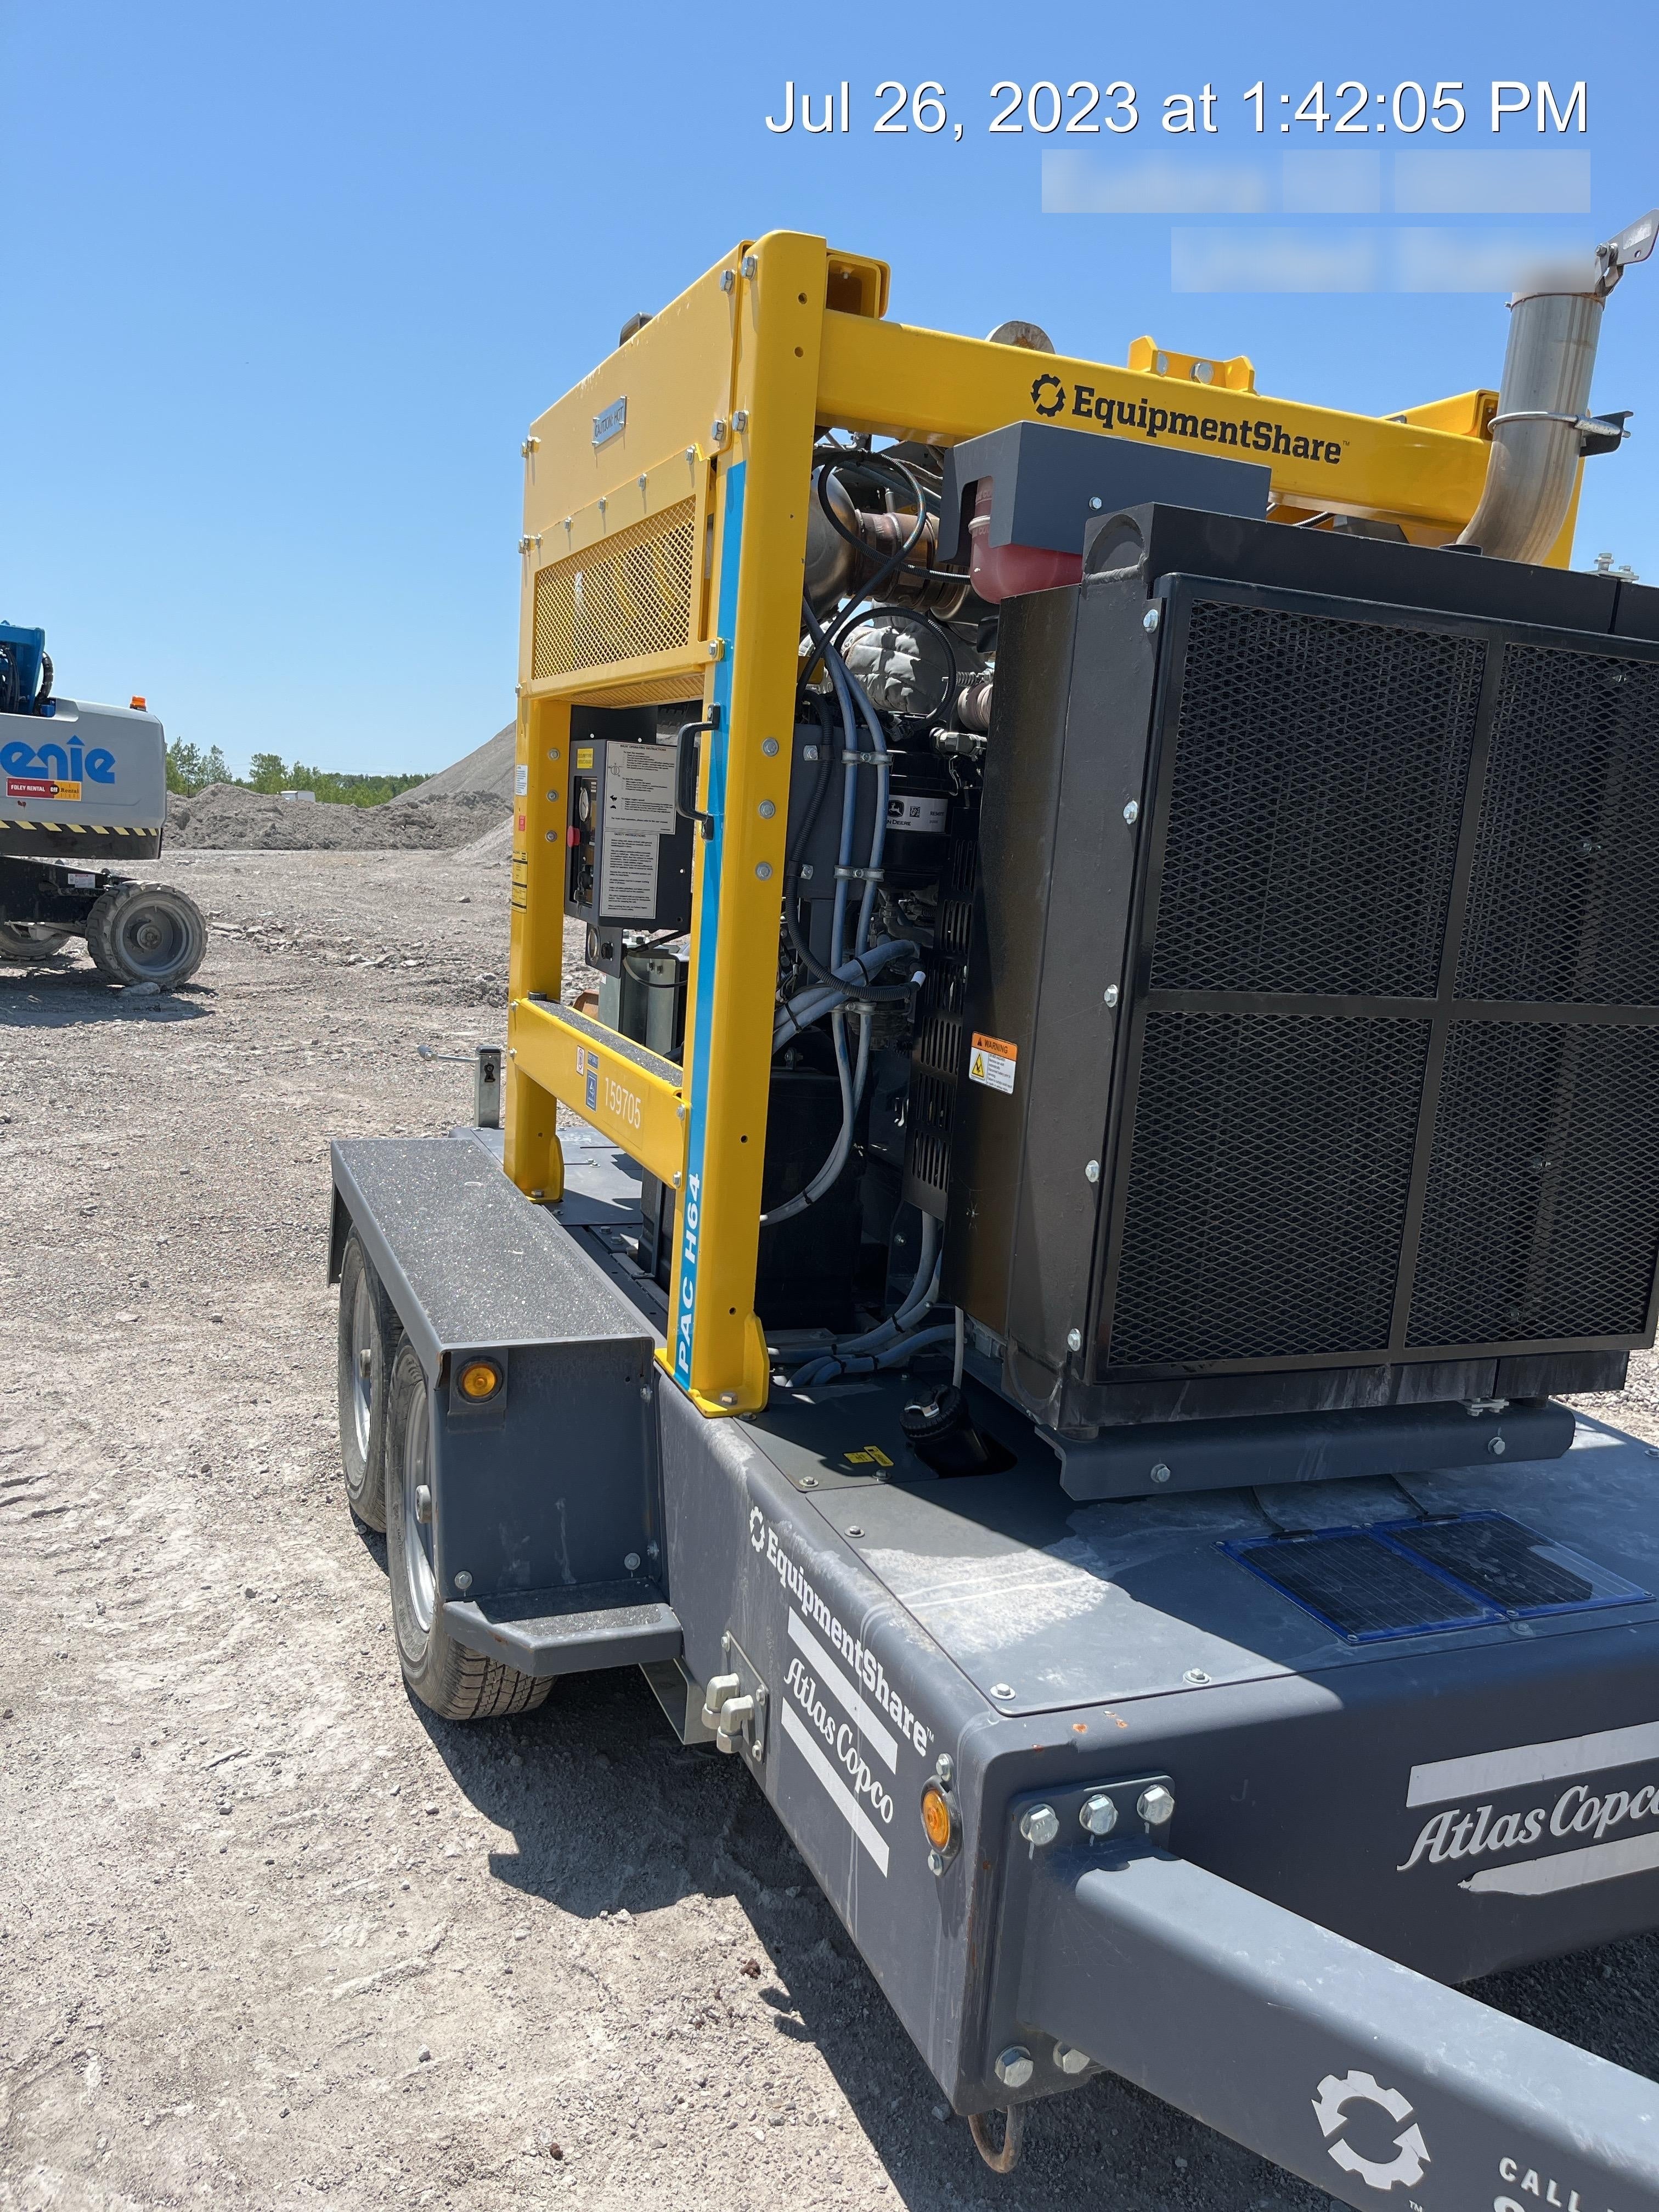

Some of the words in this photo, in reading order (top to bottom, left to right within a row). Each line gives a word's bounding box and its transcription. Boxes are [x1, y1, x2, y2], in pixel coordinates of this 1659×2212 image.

[1071, 385, 1342, 466] EquipmentShare
[984, 1039, 1008, 1054] WARNING
[606, 1077, 641, 1129] 159705
[685, 1173, 700, 1265] H64
[678, 1276, 694, 1374] PAC
[766, 1526, 928, 1758] EquipmentShare
[783, 1658, 836, 1746] Atlas
[836, 1723, 894, 1824] Copco
[1396, 1805, 1545, 1871] Atlas
